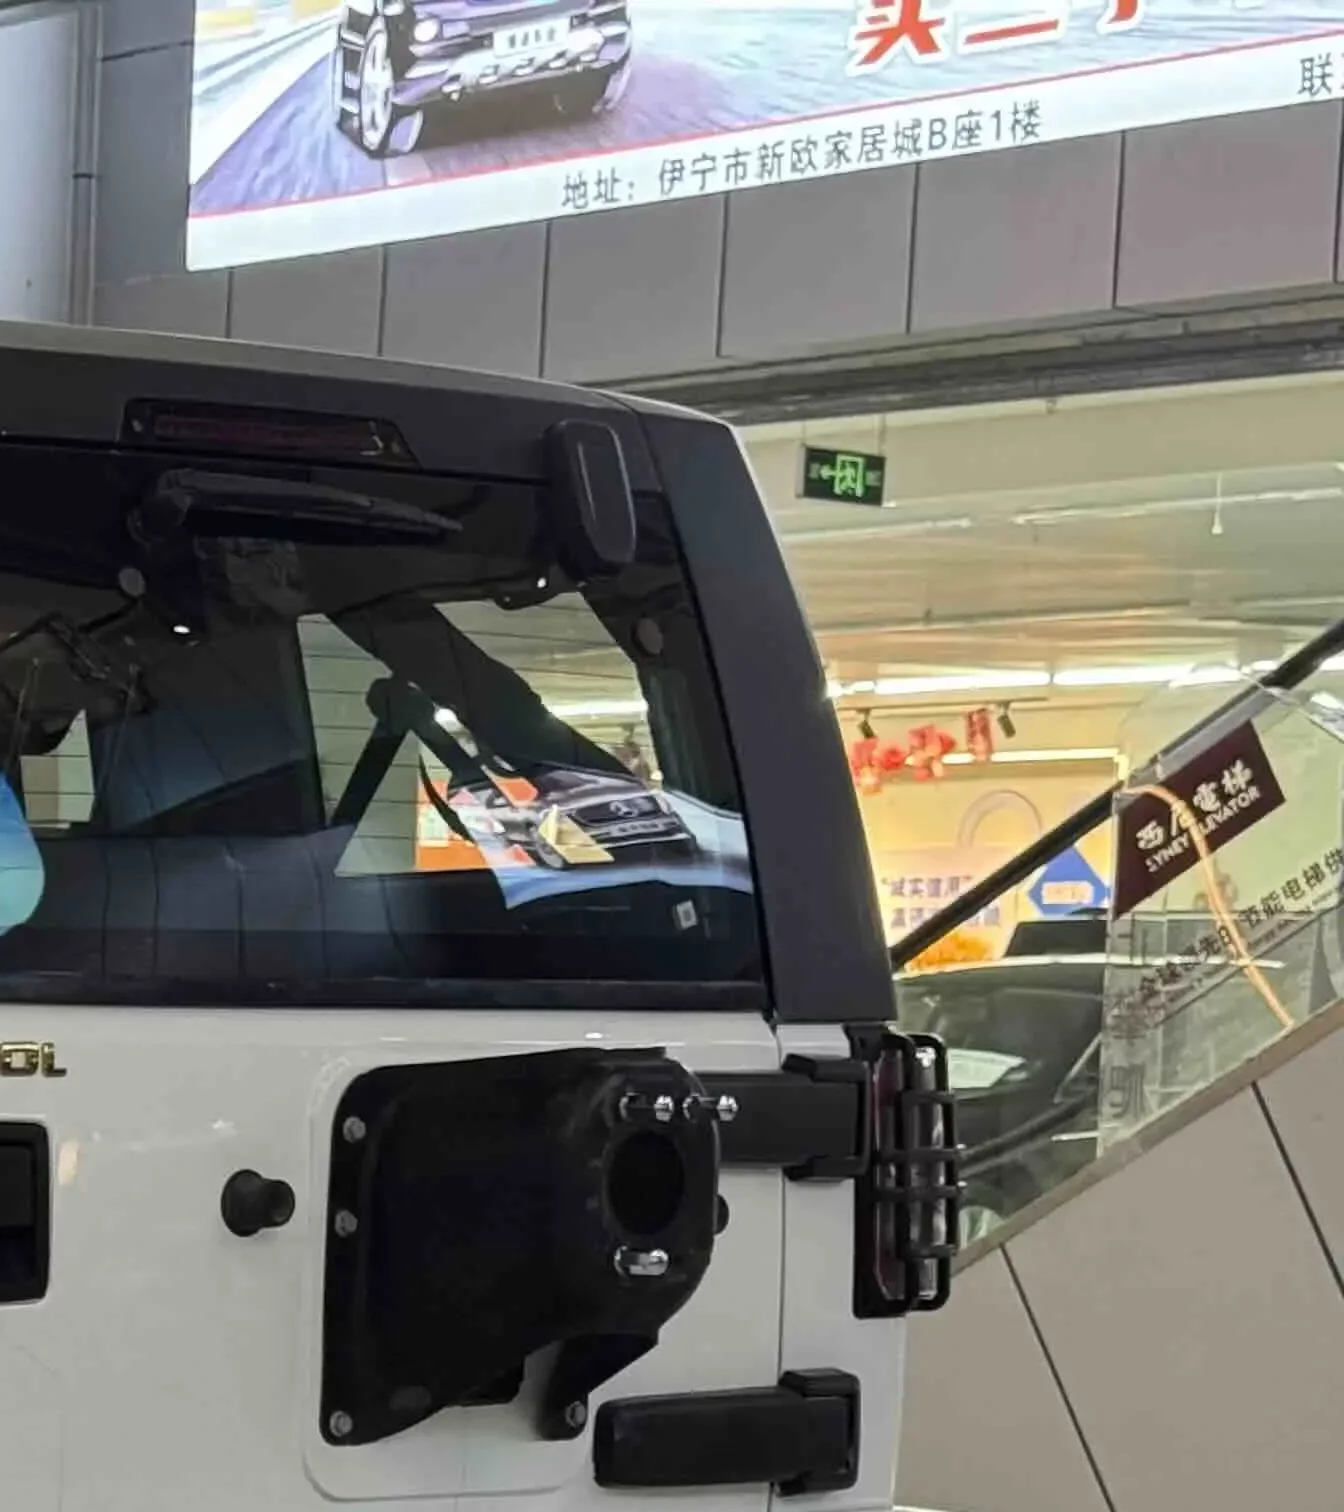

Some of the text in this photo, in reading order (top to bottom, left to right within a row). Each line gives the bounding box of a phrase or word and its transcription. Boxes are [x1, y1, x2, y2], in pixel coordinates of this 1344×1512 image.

[1296, 51, 1344, 97] 联
[561, 99, 1041, 210] 地址： 伊宁市新欧家居城B座1楼
[1195, 785, 1261, 837] LEVATOR
